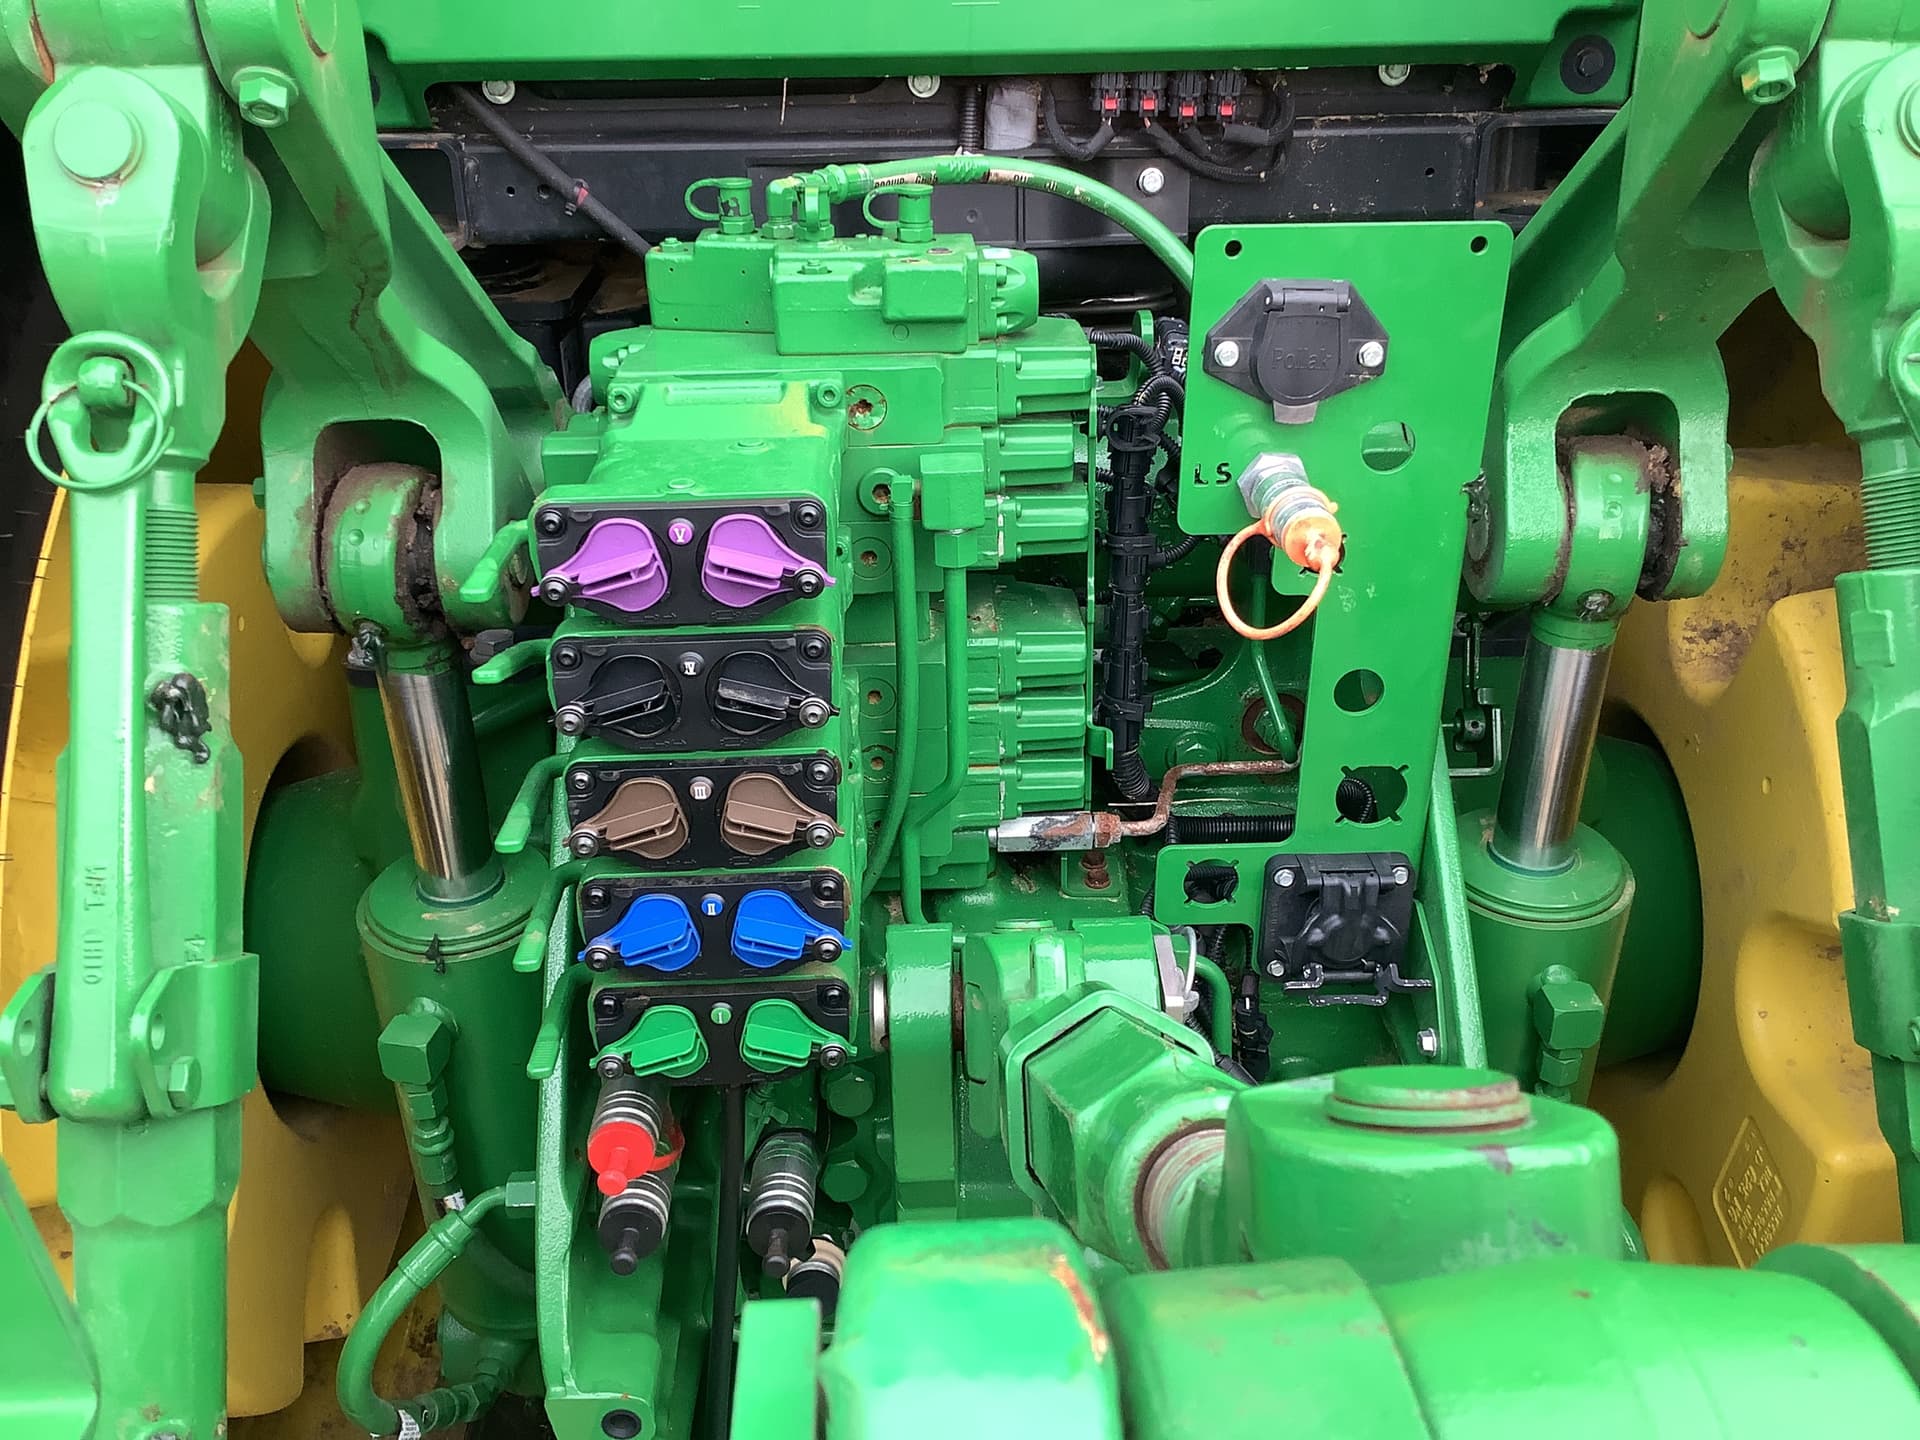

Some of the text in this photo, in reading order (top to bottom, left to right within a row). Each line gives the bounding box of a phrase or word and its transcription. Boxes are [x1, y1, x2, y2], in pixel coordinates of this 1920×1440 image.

[673, 527, 687, 544] V
[683, 660, 697, 676] IV
[706, 902, 717, 917] II
[717, 1010, 725, 1025] I
